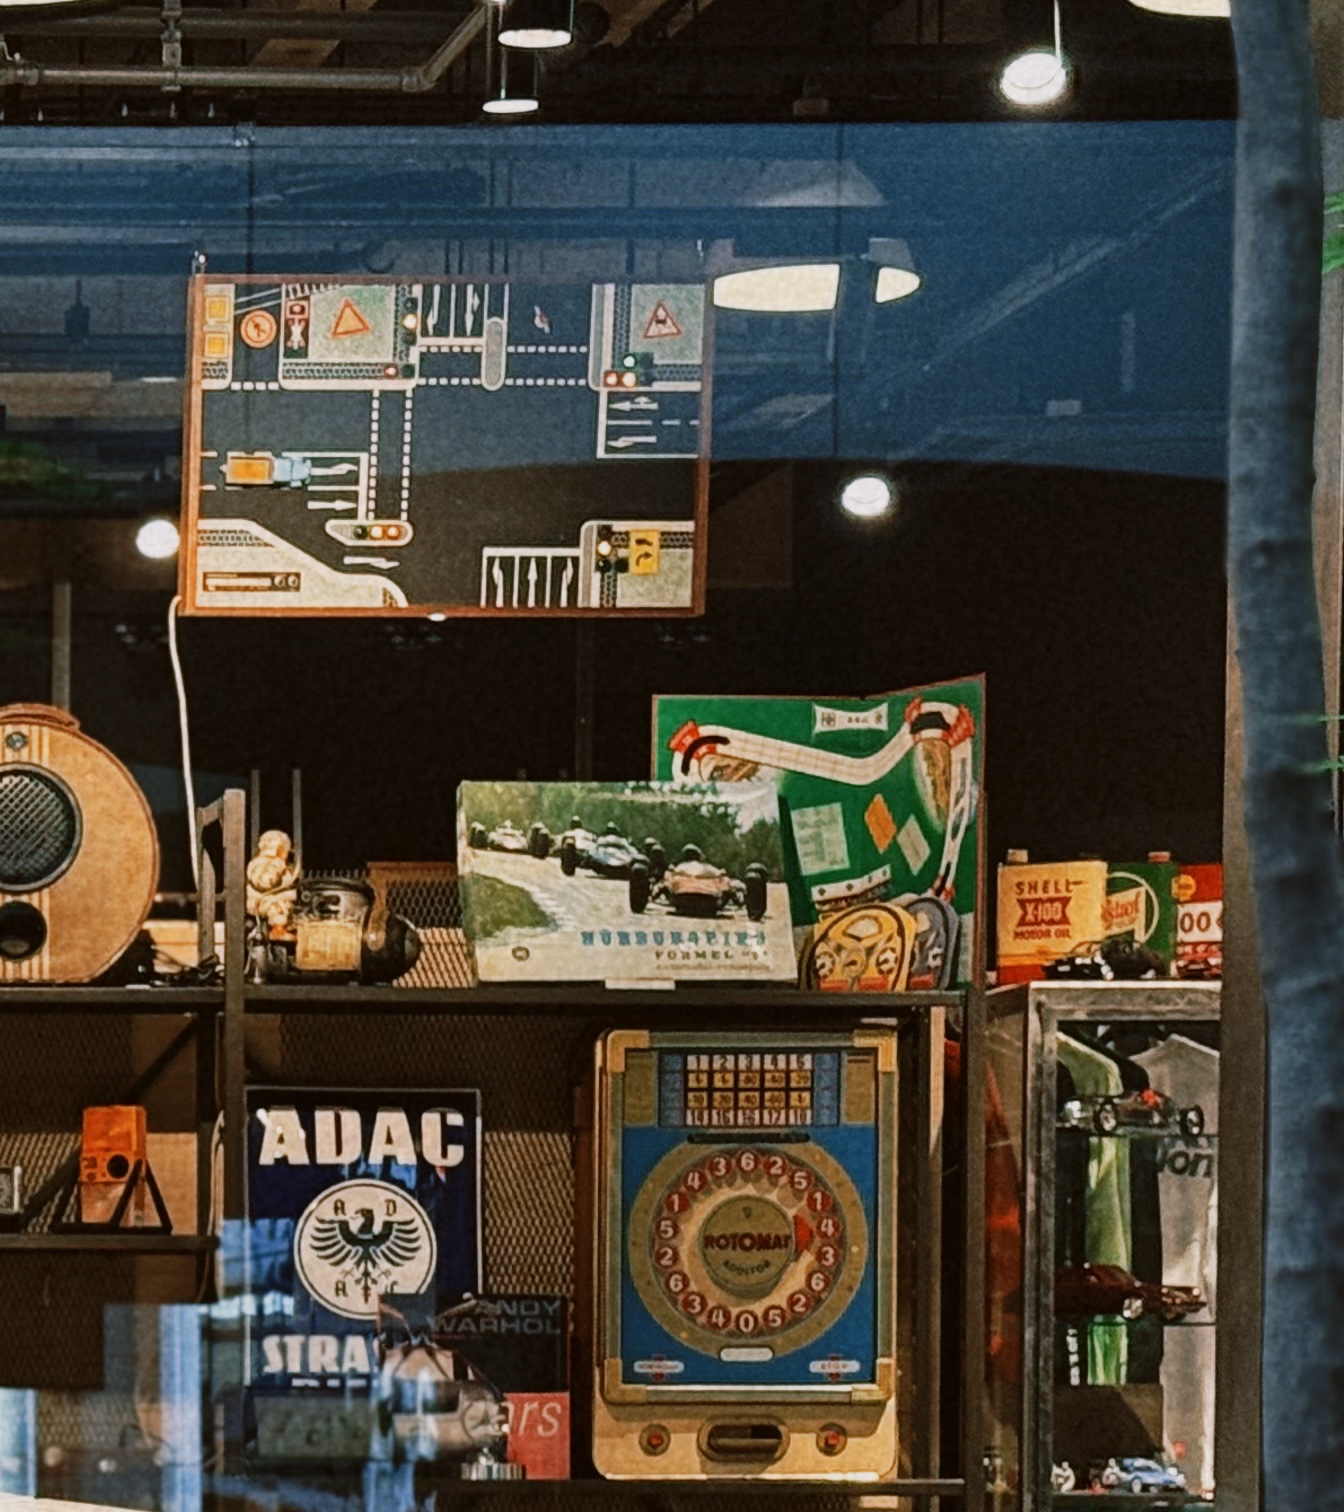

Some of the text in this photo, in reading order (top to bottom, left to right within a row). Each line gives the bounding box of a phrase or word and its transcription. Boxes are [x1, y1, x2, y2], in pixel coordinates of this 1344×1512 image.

[1014, 879, 1074, 894] SHELL
[655, 950, 734, 961] FORMEL
[258, 1105, 465, 1168] ADAC
[715, 1158, 727, 1176] 3
[741, 1153, 754, 1172] 6
[771, 1157, 783, 1175] 2
[688, 1171, 701, 1190] 4
[794, 1172, 807, 1190] 5
[384, 1198, 397, 1216] D
[672, 1193, 681, 1211] 1
[813, 1192, 823, 1210] 1
[661, 1220, 673, 1239] 5
[820, 1219, 833, 1237] 4
[704, 1232, 792, 1252] ROTOMAT
[660, 1248, 673, 1266] 2
[822, 1247, 834, 1266] 3
[669, 1274, 683, 1292] 6
[811, 1274, 824, 1292] 6
[475, 1299, 561, 1316] ANDY
[688, 1294, 701, 1313] 3
[793, 1294, 805, 1312] 2
[430, 1317, 561, 1335] WARHOL
[712, 1310, 725, 1329] 4
[740, 1314, 753, 1332] 0
[769, 1310, 781, 1328] 5
[262, 1335, 379, 1374] STRA
